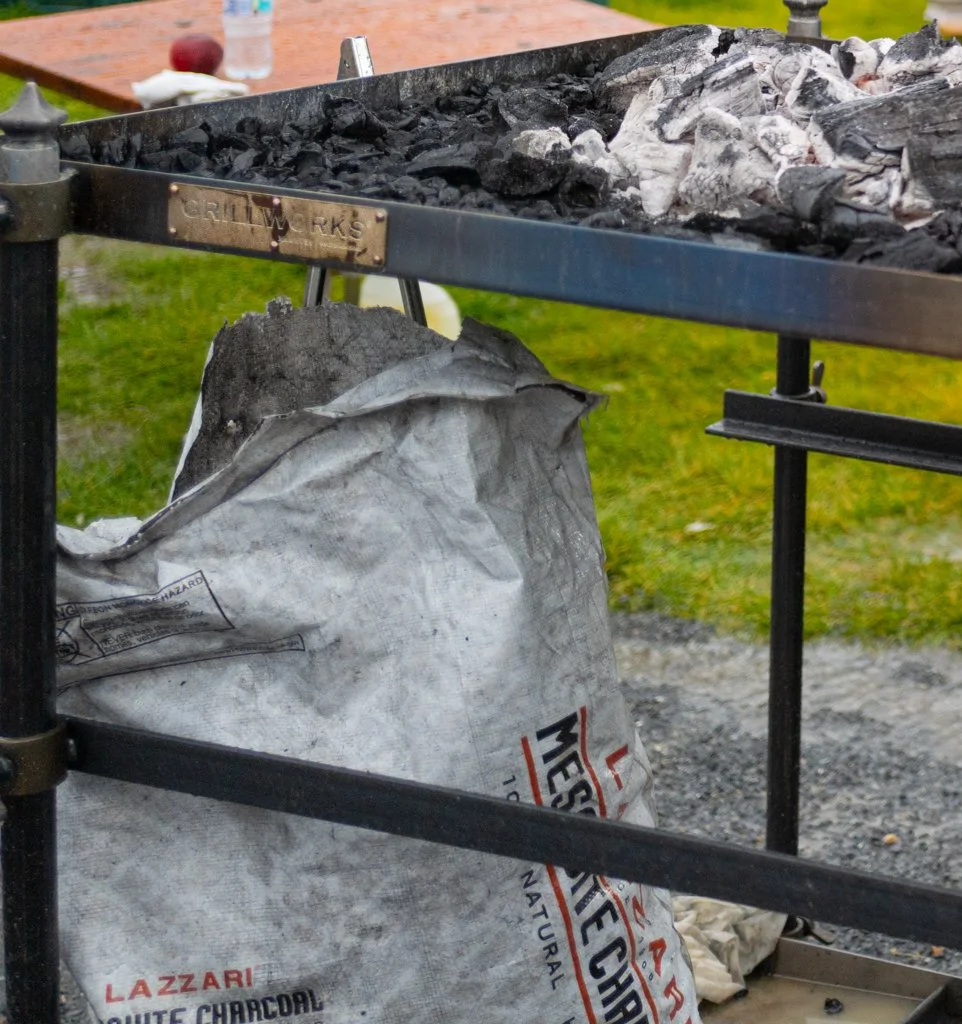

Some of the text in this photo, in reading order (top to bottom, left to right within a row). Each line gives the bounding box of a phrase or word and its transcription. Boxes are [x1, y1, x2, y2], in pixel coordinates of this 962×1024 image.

[160, 576, 204, 602] HAZARD
[535, 711, 620, 947] MESITE
[520, 869, 566, 991] NATURAL
[104, 967, 254, 1004] LAZZARI
[196, 989, 324, 1024] CHARCOAL
